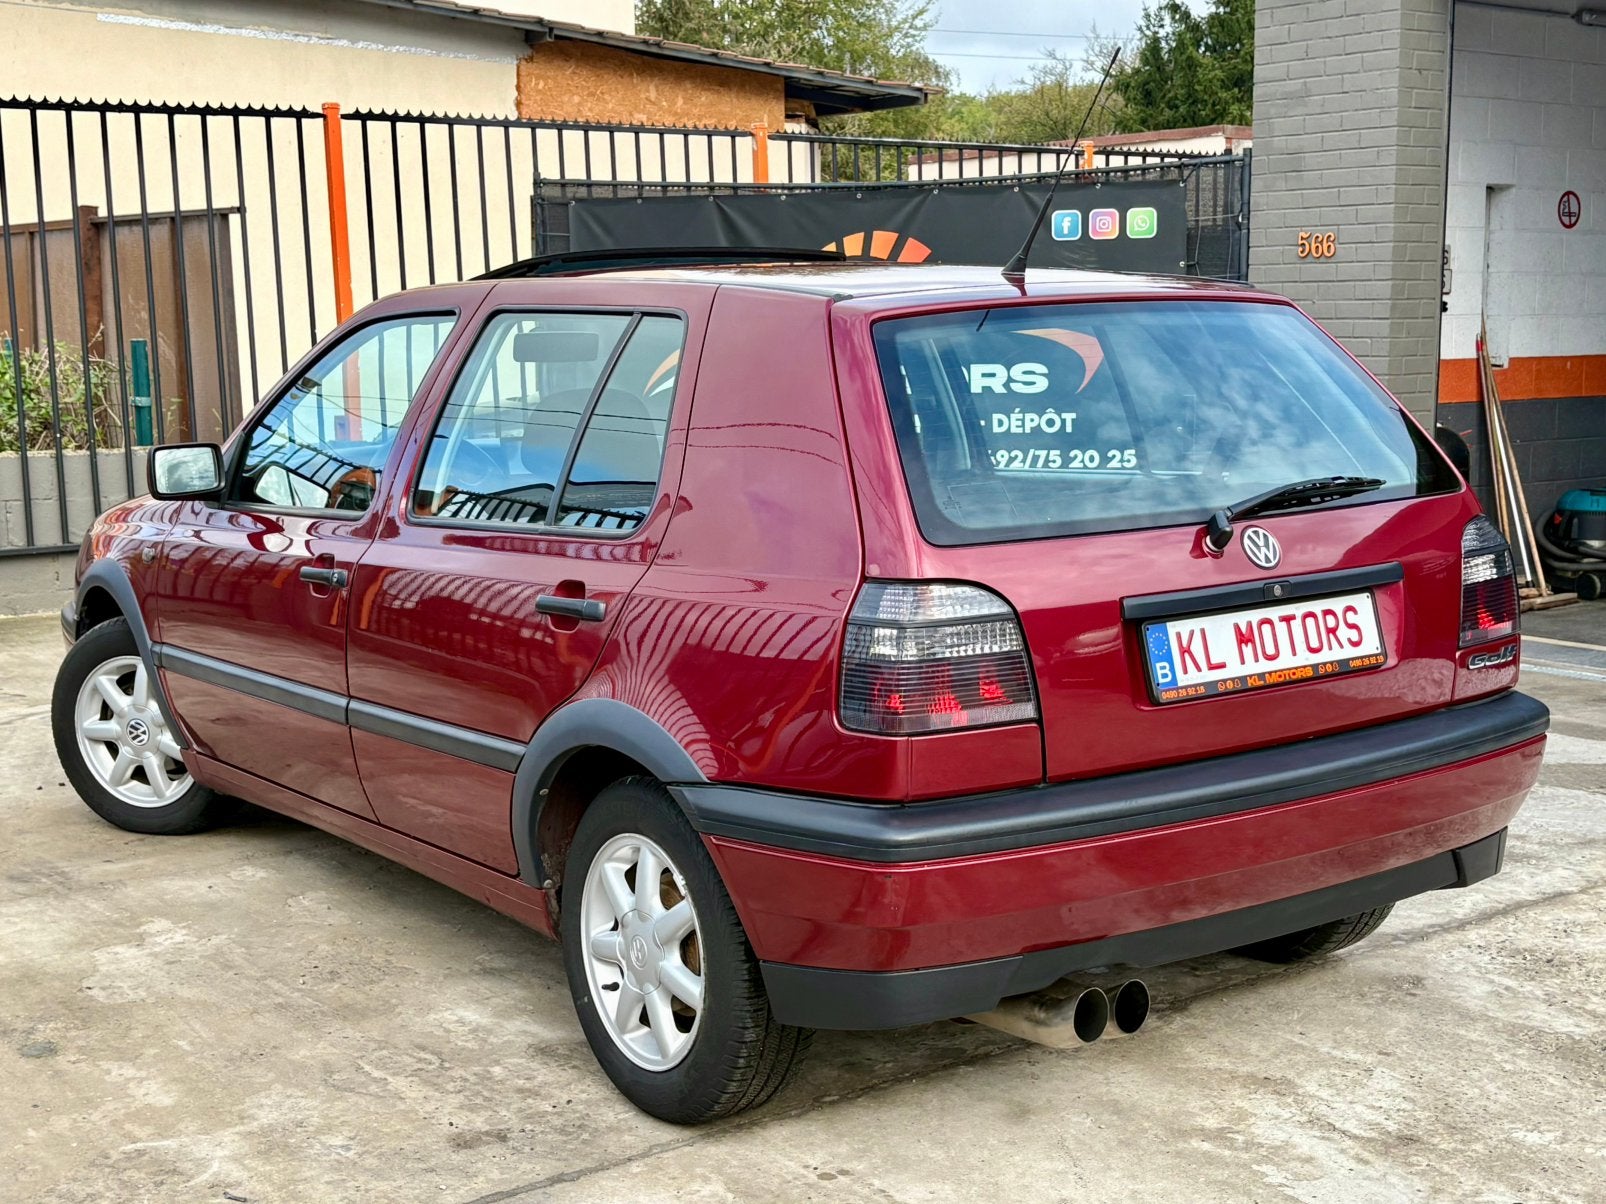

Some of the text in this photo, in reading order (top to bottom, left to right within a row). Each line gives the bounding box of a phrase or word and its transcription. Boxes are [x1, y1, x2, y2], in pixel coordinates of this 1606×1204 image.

[1298, 231, 1336, 258] 566
[962, 362, 1049, 393] RS
[992, 408, 1076, 433] DÉPÔT
[1068, 449, 1100, 468] 20
[1106, 449, 1137, 468] 25
[1242, 526, 1280, 569] VW
[1176, 605, 1363, 675] KL MOTORS
[1155, 661, 1172, 683] B
[1247, 666, 1313, 687] KL MOTORS
